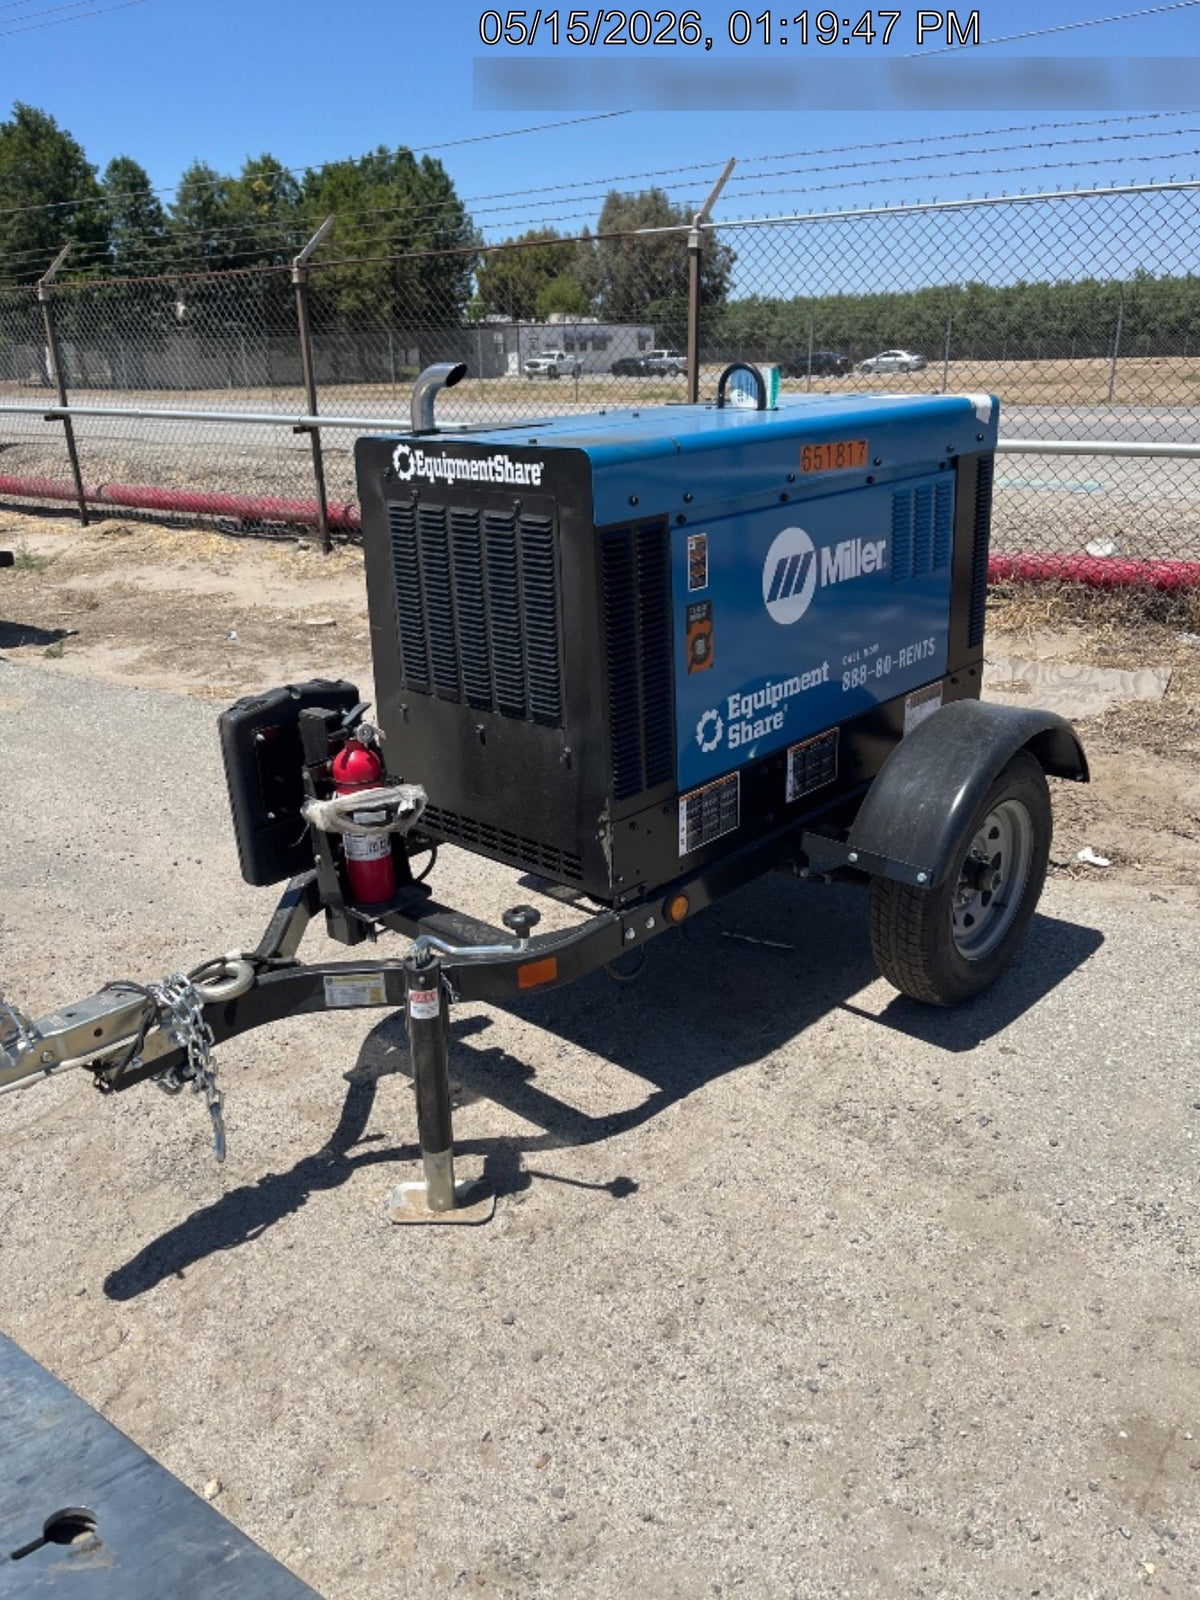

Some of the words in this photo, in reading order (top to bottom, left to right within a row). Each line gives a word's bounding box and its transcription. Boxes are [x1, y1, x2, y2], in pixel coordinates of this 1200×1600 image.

[414, 450, 541, 486] EquipmentShare
[802, 441, 867, 472] 651817
[821, 538, 886, 587] Miller
[727, 661, 830, 720] Equipment
[728, 712, 784, 749] Share
